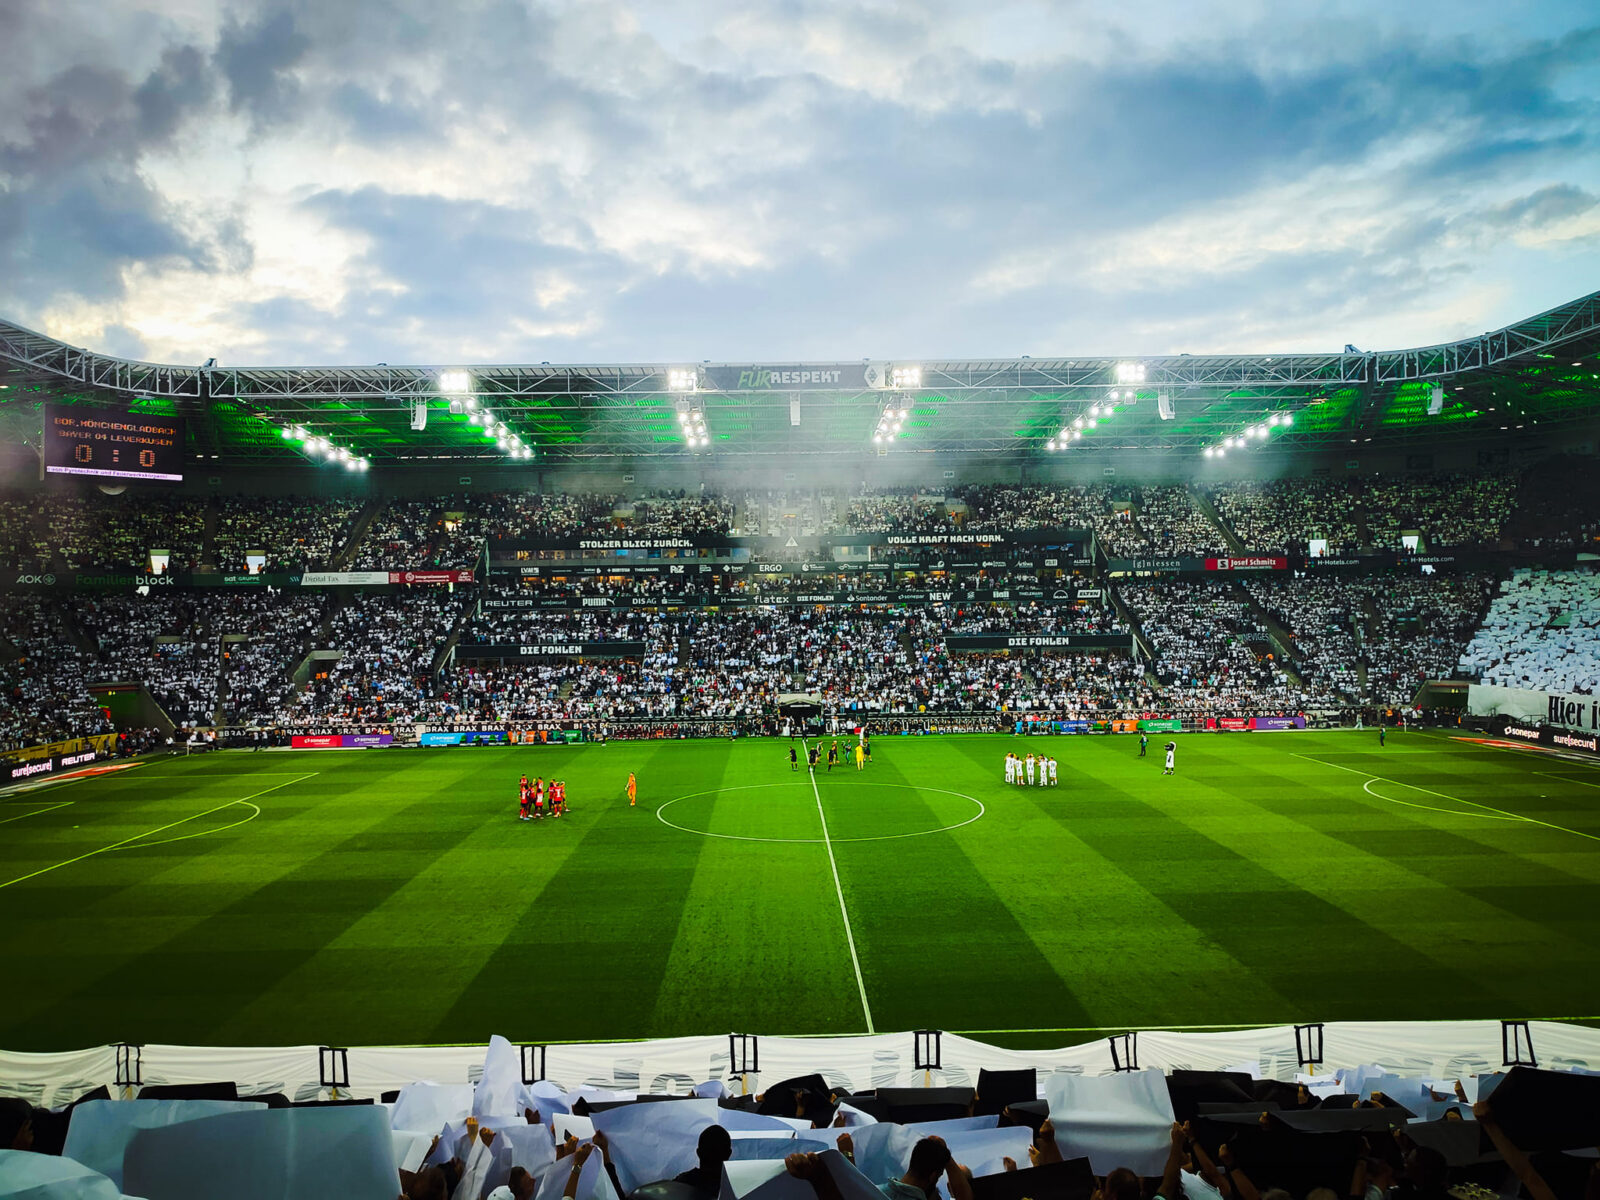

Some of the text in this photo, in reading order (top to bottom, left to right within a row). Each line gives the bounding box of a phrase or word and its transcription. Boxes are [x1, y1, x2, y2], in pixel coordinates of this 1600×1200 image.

[737, 366, 841, 389] FÜR RESPEKT
[58, 429, 173, 446] BAYER 04 LEVERKUSEN
[75, 444, 92, 463] 0
[139, 449, 156, 467] 0
[579, 538, 694, 548] STOLZER BLICK ZURÜCK.
[887, 534, 1005, 544] VOLLE KRAFT NACH VORN.
[759, 564, 783, 572] ERGO
[1230, 559, 1248, 568] Josef
[1249, 558, 1276, 566] Schmitz
[16, 575, 43, 584] AOK
[75, 574, 174, 585] Familienblock
[582, 597, 607, 606] PUMA
[646, 597, 657, 605] AG
[753, 595, 790, 604] flatex
[855, 594, 888, 602] Santander
[929, 592, 952, 601] NEW
[1008, 637, 1069, 646] DIE FOHLEN
[520, 645, 582, 655] DIE FOHLEN
[1548, 695, 1600, 730] Hier i
[426, 725, 449, 733] BRAX
[481, 724, 506, 732] BRAX
[537, 723, 561, 731] BRAX
[1511, 729, 1540, 739] sonepar
[1553, 735, 1597, 751] sure[secure]
[61, 752, 96, 766] REUTER
[11, 759, 53, 778] sure[secure]
